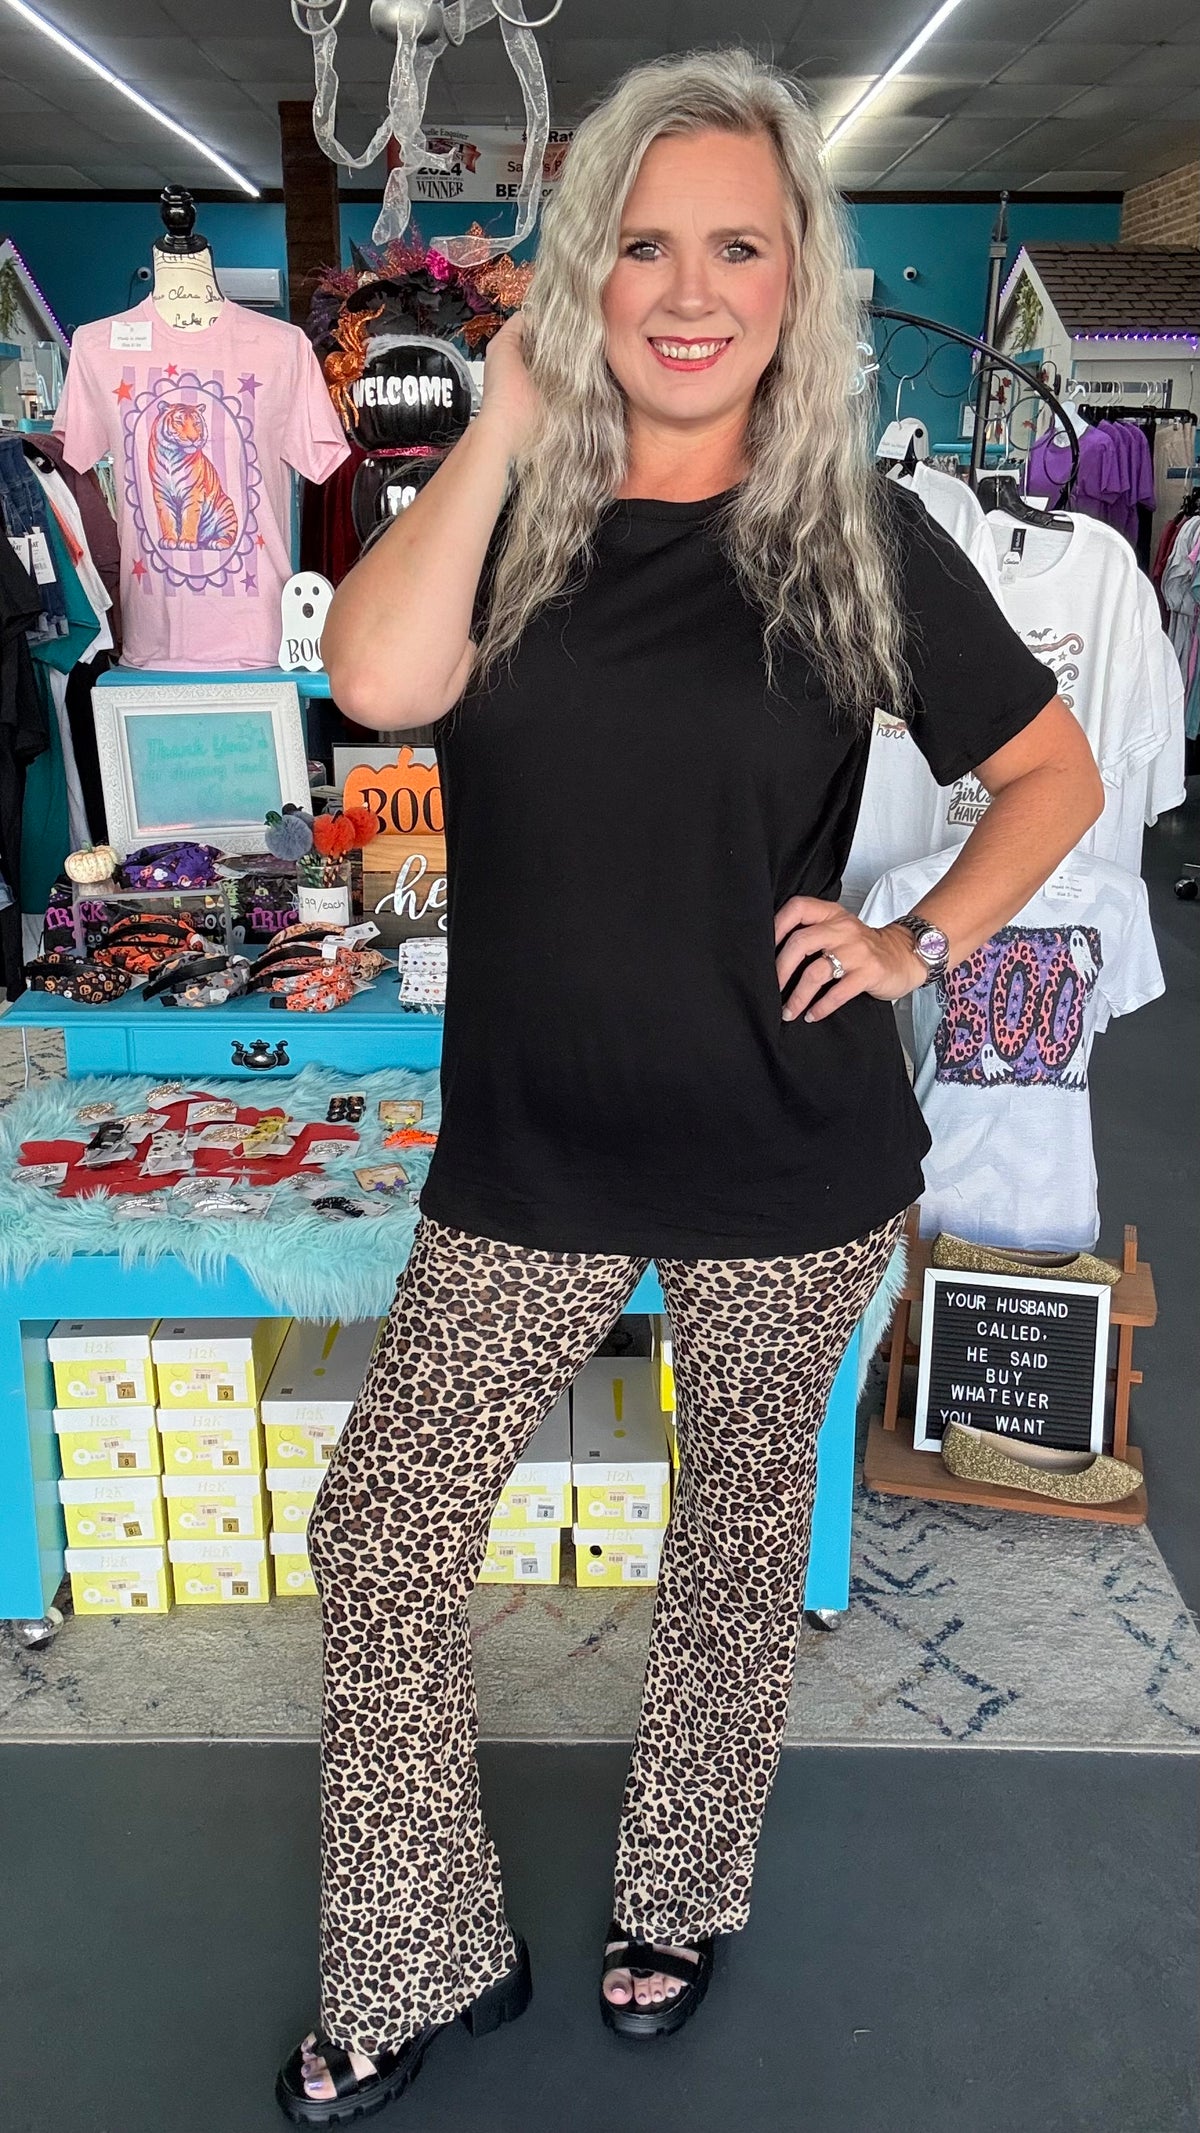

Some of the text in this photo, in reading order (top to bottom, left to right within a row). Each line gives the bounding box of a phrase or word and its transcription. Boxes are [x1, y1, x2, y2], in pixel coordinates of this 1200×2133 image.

[548, 131, 574, 143] Rat
[507, 160, 551, 173] Sa's
[416, 181, 464, 199] WINNER
[352, 375, 453, 408] WELCOME
[387, 485, 417, 515] TO
[875, 724, 906, 739] here
[374, 854, 447, 931] he
[246, 907, 300, 932] TRIC
[941, 940, 1085, 1070] BOO
[946, 1291, 1069, 1318] YOUR HUSBAND
[977, 1321, 1048, 1342] CALLED,
[966, 1346, 1048, 1369] HE SAID
[985, 1368, 1023, 1386] BUY
[223, 1390, 229, 1399] 9
[951, 1384, 1049, 1410] WHATEVER
[940, 1409, 1046, 1436] YOU WANT
[227, 1456, 233, 1464] 9
[543, 1510, 548, 1518] 8
[637, 1509, 643, 1517] 9
[227, 1523, 233, 1532] 9
[635, 1568, 641, 1576] 9
[235, 1586, 245, 1595] 10
